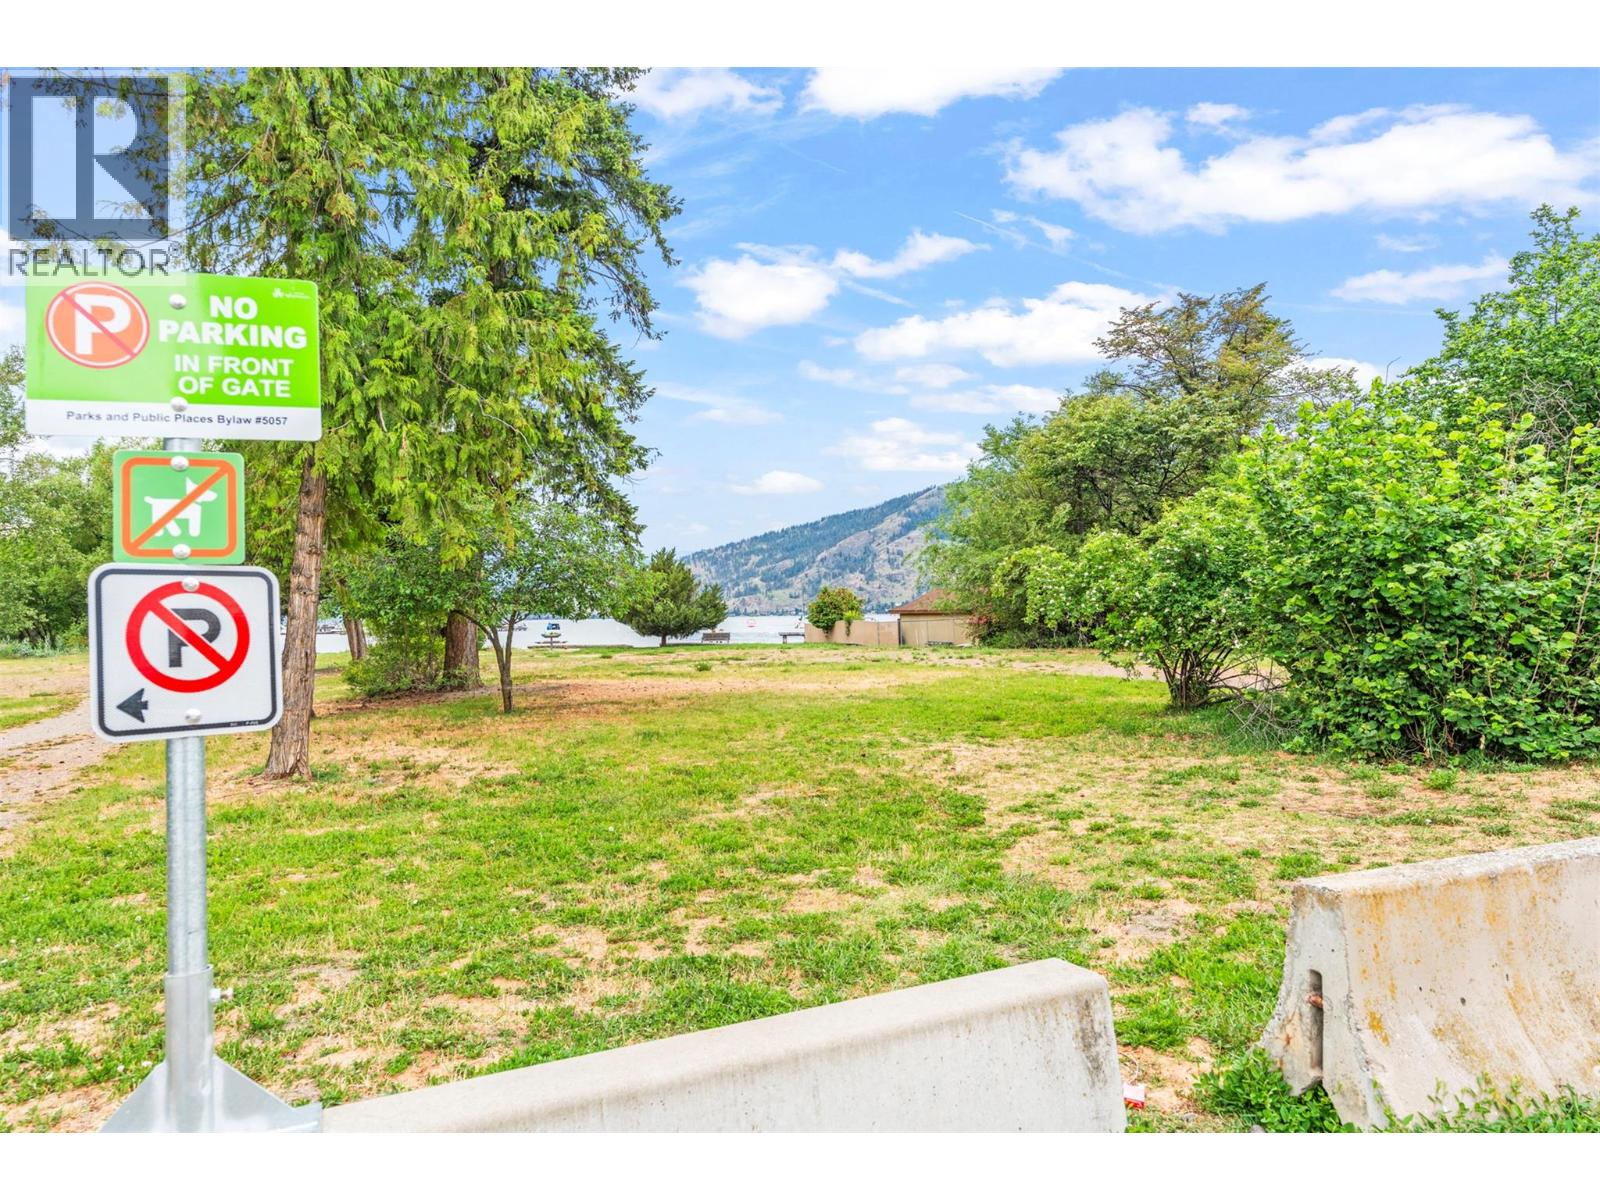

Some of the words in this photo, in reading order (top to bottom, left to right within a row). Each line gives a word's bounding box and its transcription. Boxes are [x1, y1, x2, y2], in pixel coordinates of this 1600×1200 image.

[209, 295, 258, 320] NO
[158, 319, 307, 349] PARKING
[174, 354, 199, 372] IN
[208, 355, 294, 376] FRONT
[178, 376, 214, 395] OF
[222, 377, 291, 398] GATE
[66, 410, 102, 421] Parks
[106, 412, 129, 422] and
[132, 413, 171, 423] Public
[174, 414, 213, 424] Places
[217, 415, 252, 426] Bylaw
[255, 416, 289, 426] #5057
[168, 607, 222, 669] P
